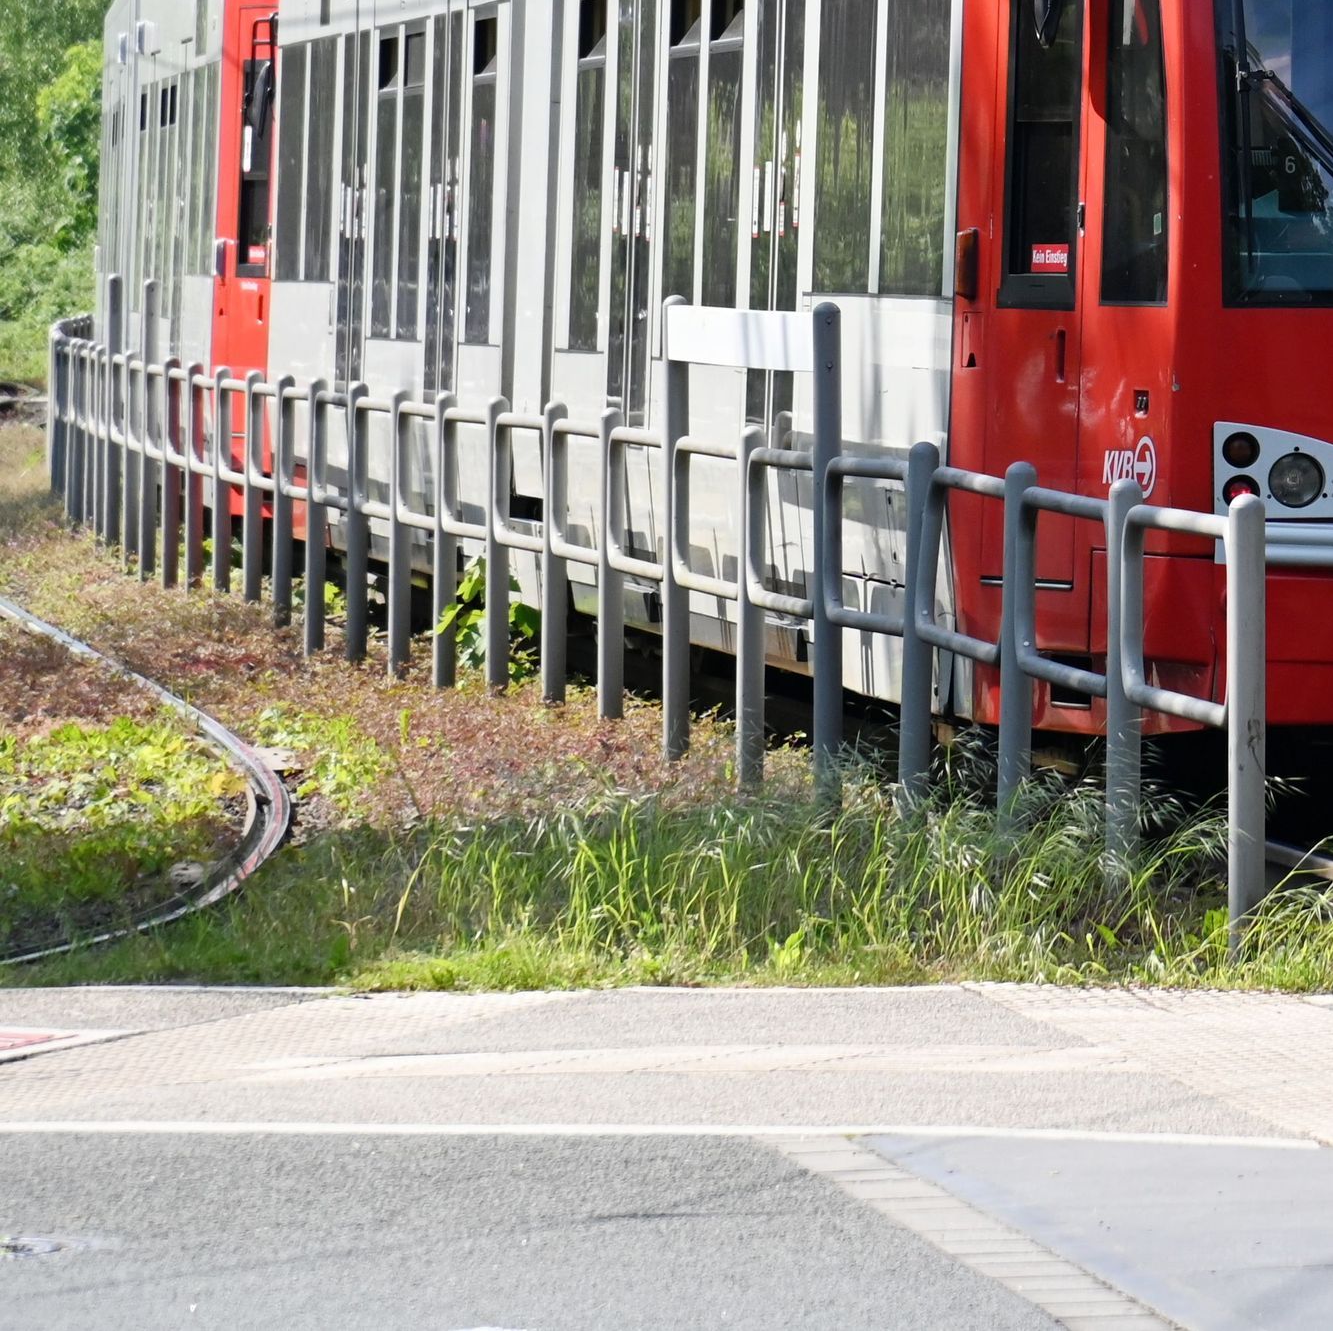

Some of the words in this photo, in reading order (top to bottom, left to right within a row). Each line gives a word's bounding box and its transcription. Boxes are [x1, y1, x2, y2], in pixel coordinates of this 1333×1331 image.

[1285, 156, 1296, 174] 6
[1032, 249, 1045, 263] Kein
[1045, 249, 1068, 267] Einstieg
[1101, 450, 1135, 484] KVB
